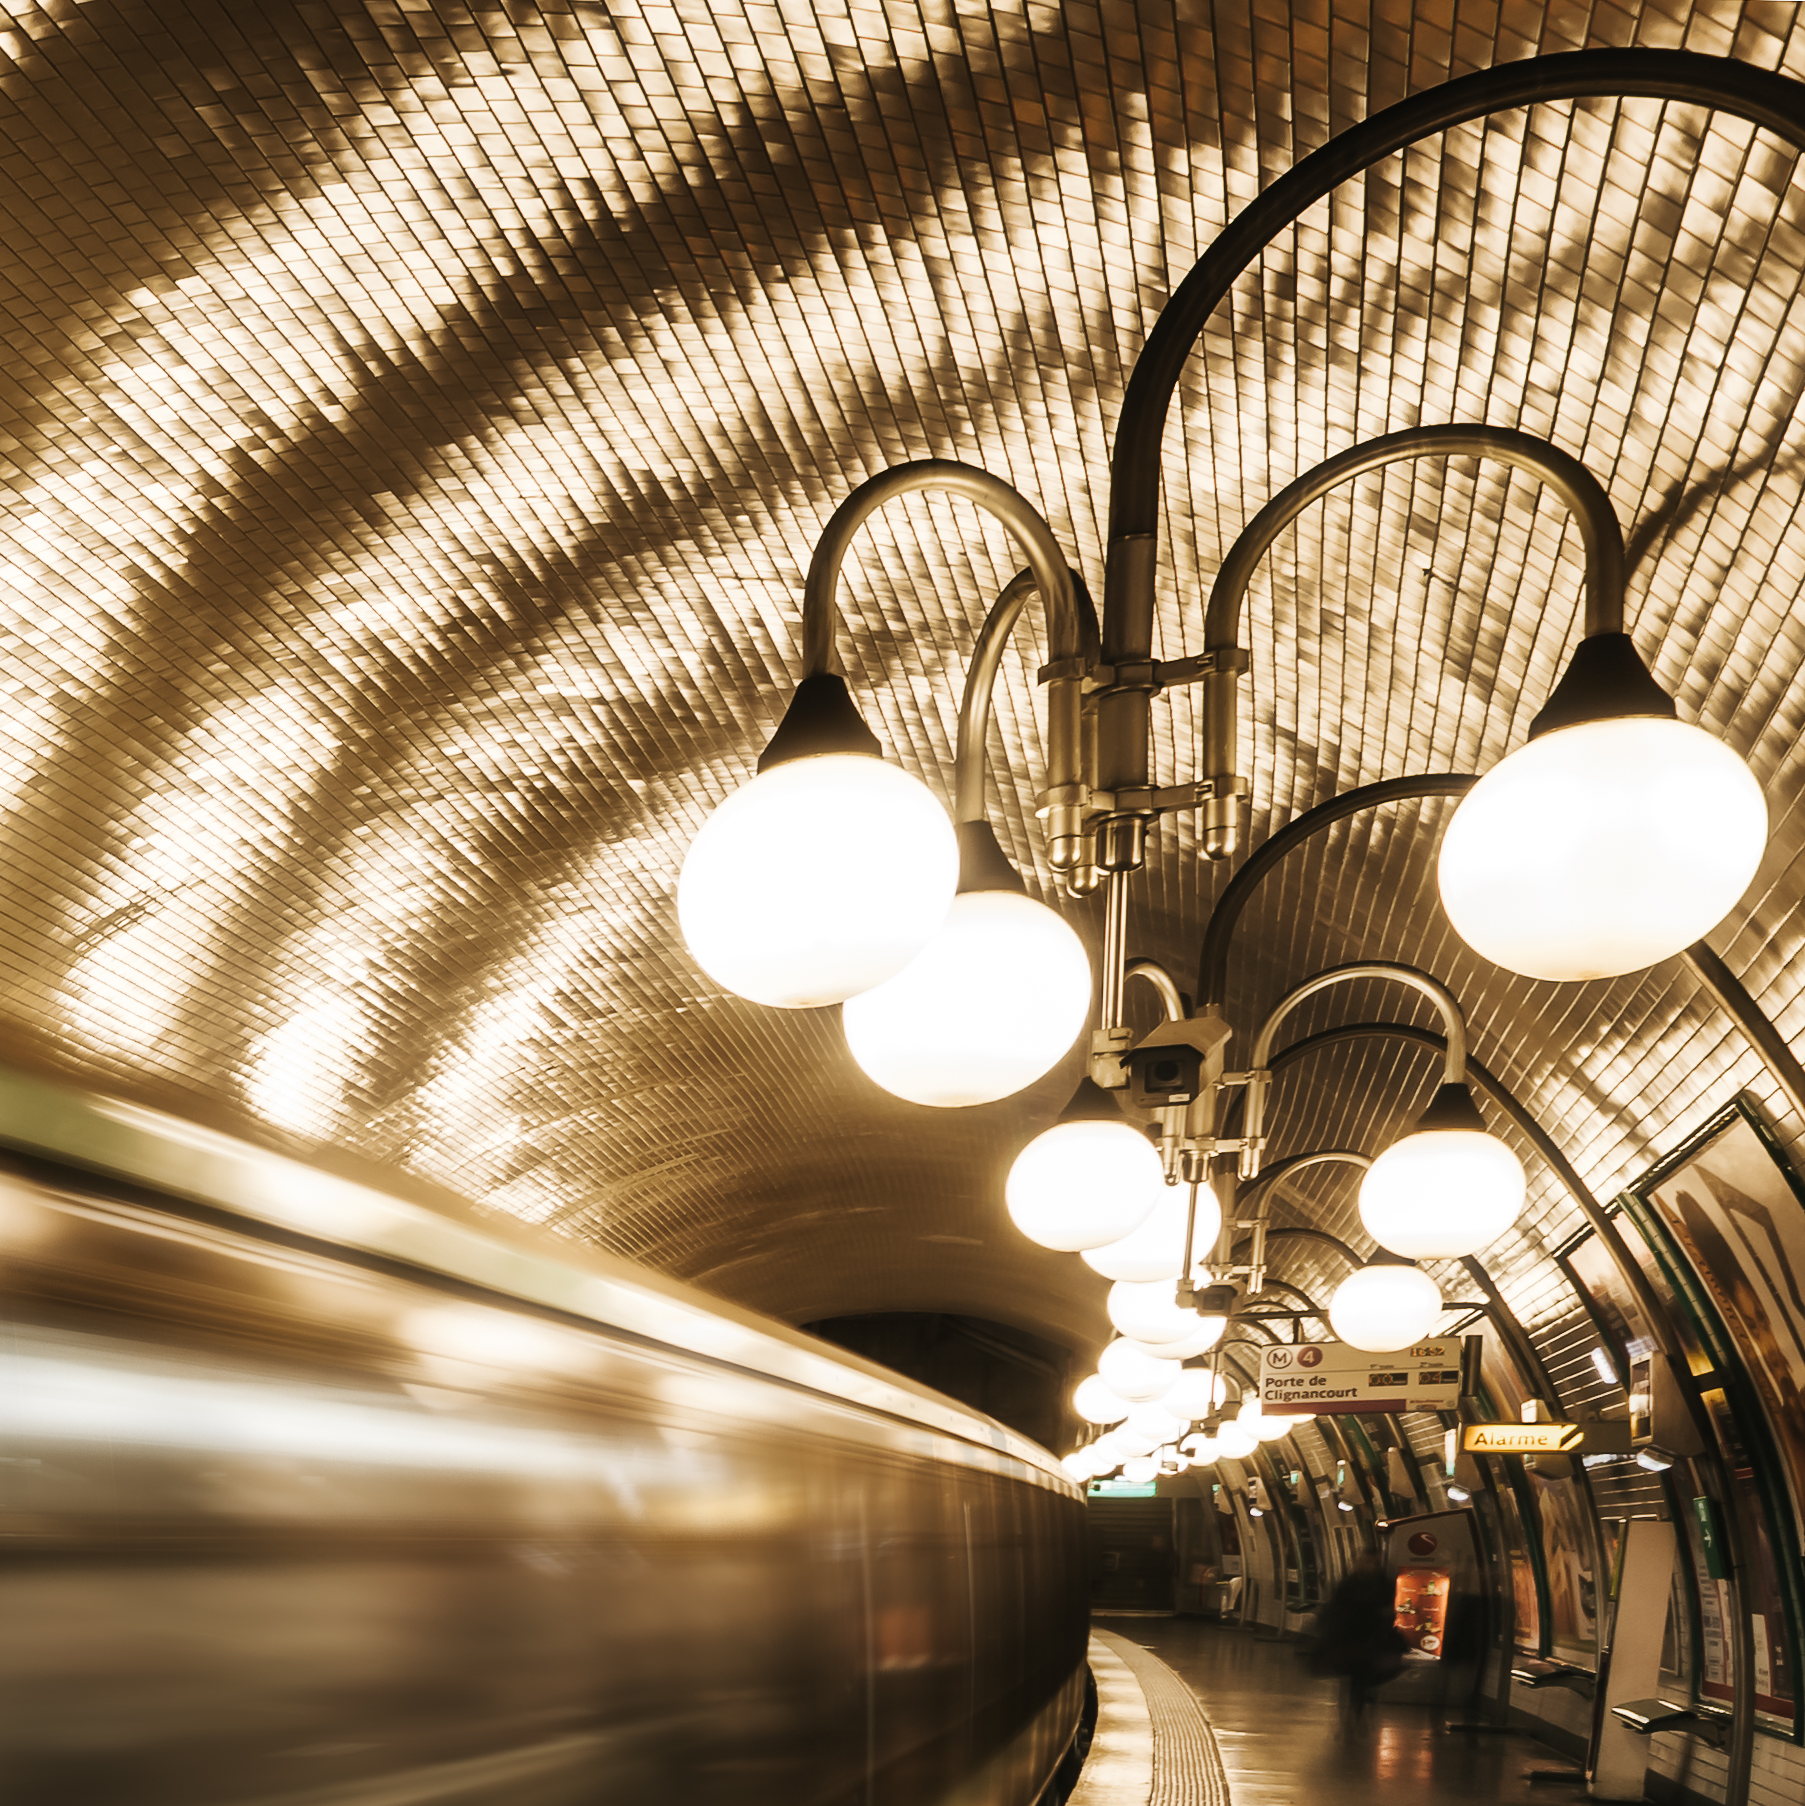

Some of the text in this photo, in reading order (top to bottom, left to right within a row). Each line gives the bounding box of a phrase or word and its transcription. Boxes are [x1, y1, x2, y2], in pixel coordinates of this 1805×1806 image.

[1302, 1350, 1315, 1364] 4
[1265, 1375, 1327, 1388] Porte de
[1264, 1387, 1358, 1402] Clignancourt
[1474, 1432, 1548, 1446] Alarme
